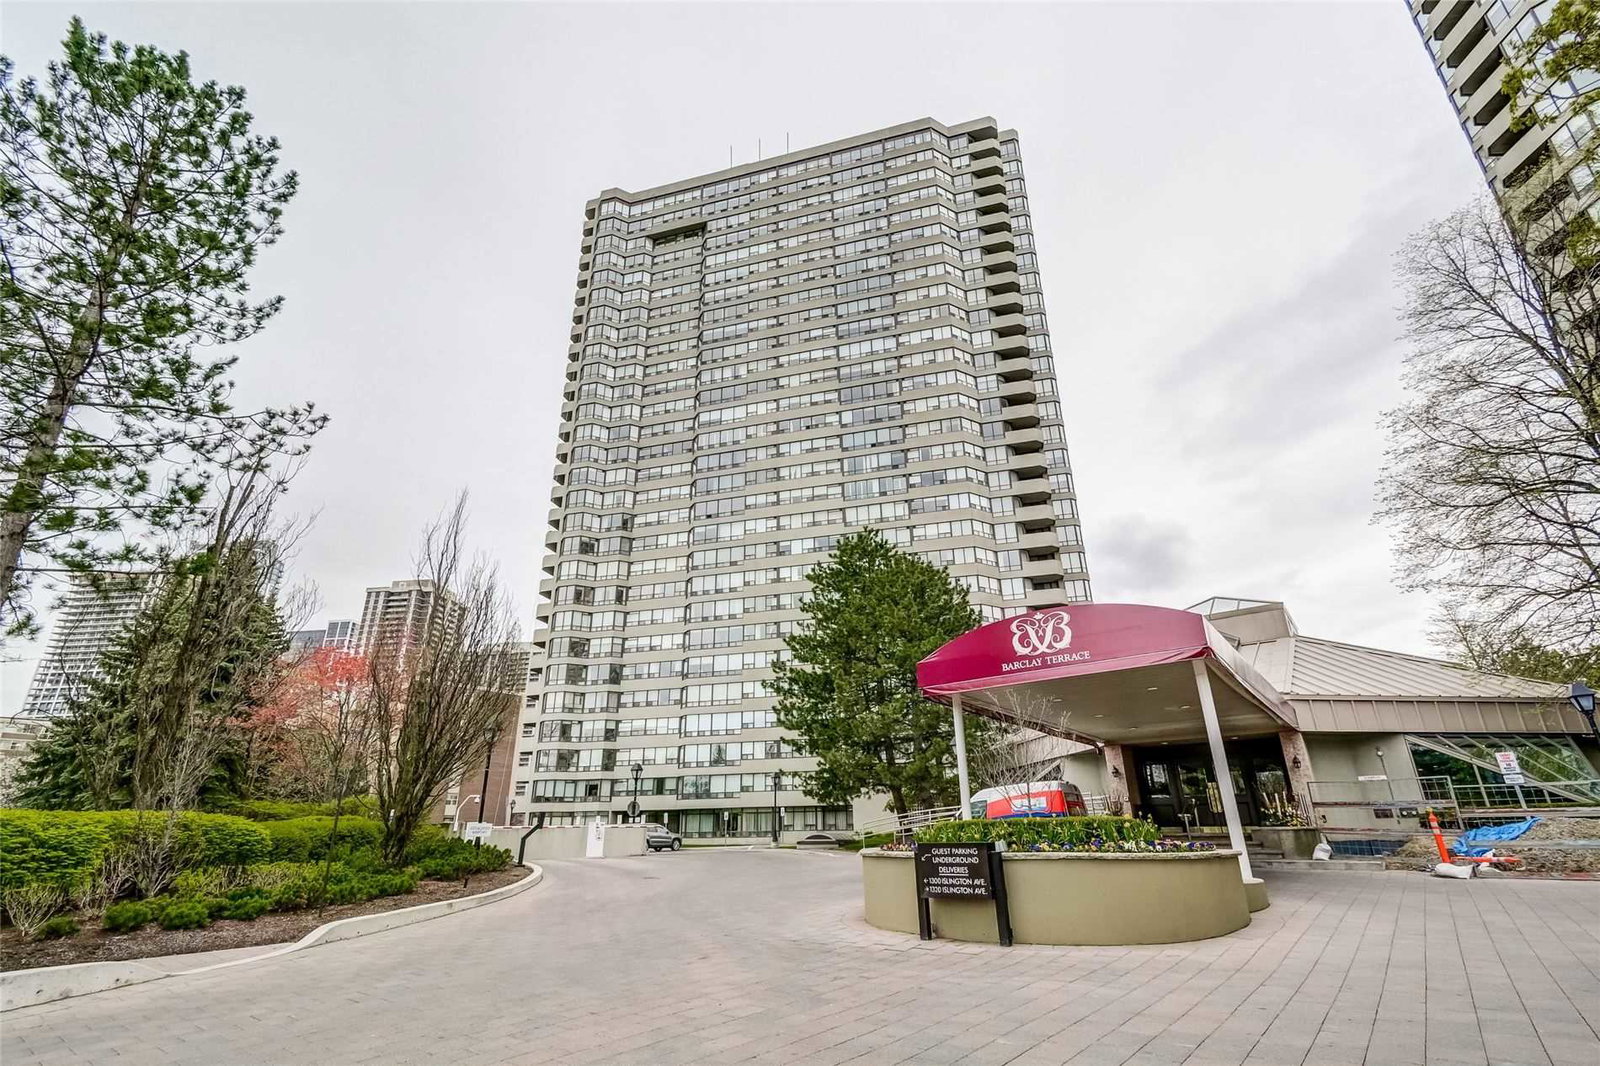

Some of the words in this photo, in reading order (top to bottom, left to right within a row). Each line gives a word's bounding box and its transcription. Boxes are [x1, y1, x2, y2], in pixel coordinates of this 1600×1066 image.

[1002, 658, 1042, 671] BARCLAY
[1044, 651, 1091, 664] TERRACE
[942, 878, 972, 886] ISLINGTON
